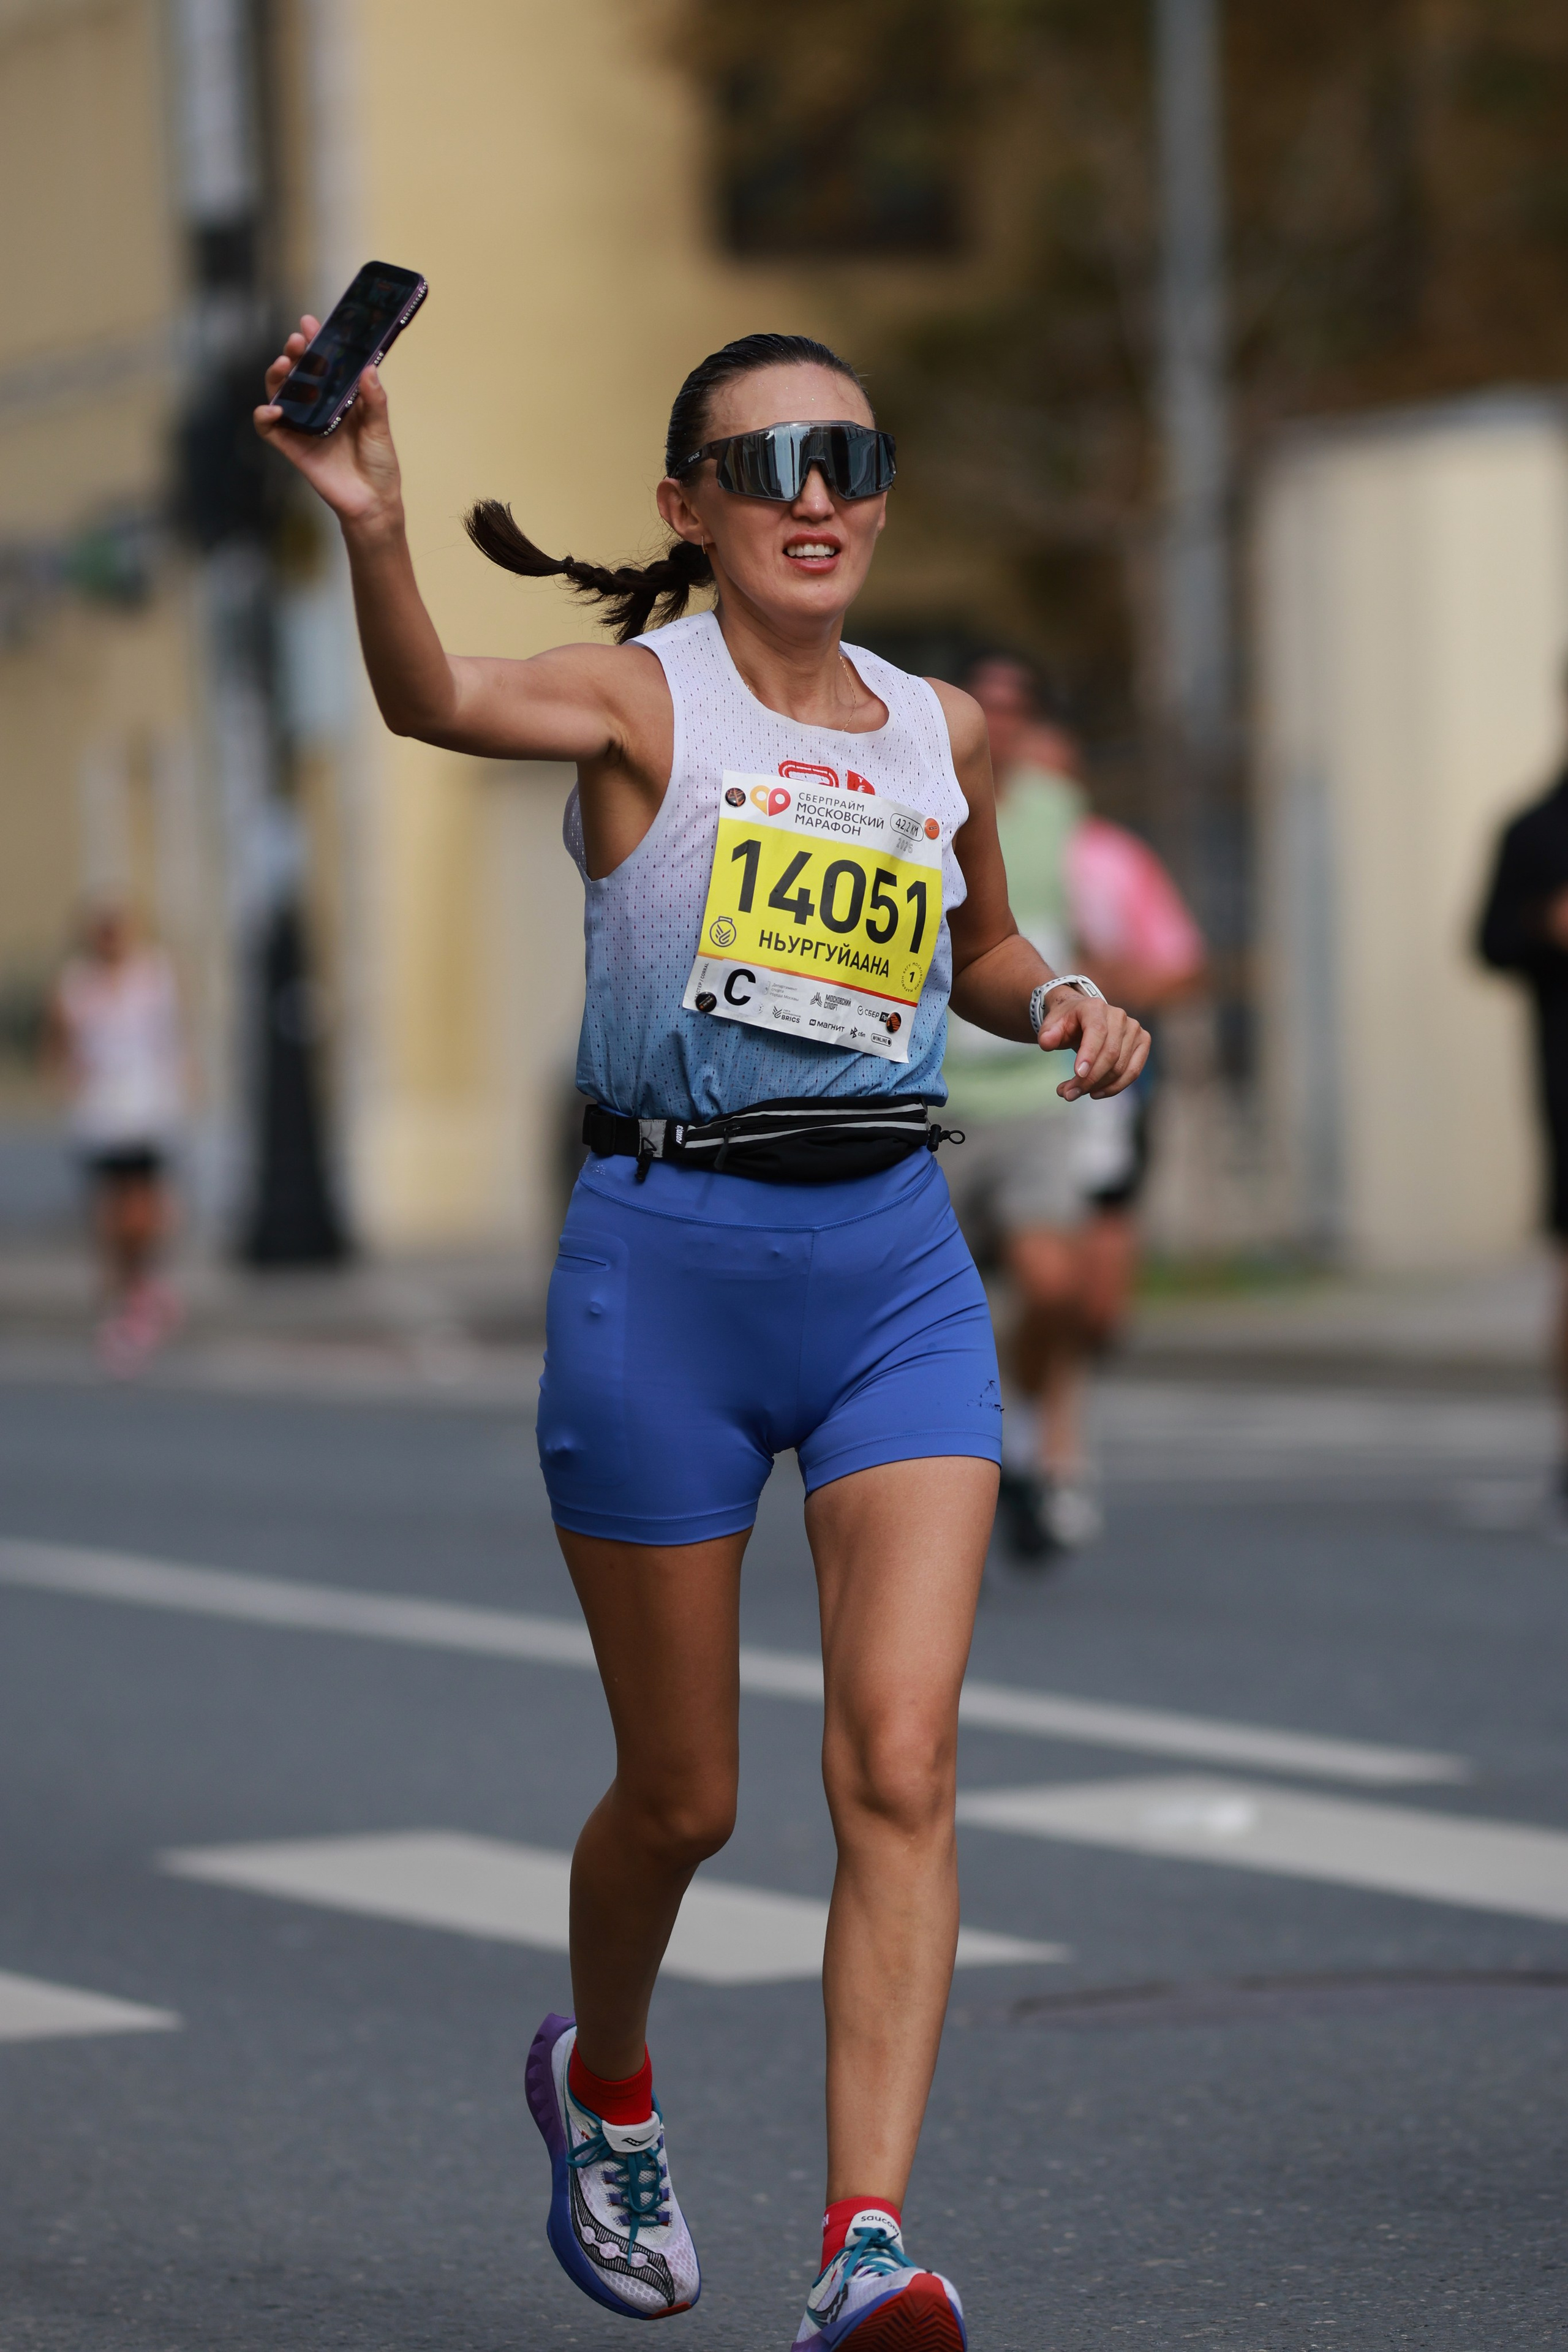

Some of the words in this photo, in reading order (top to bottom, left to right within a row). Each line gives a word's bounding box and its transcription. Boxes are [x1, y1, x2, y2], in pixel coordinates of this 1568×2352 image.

[798, 792, 865, 812] СБЕРПРАЙМ
[796, 802, 884, 829] МОСКОВСКИЙ
[794, 814, 861, 836] МАРАФОН
[895, 818, 911, 832] 42,2
[731, 839, 927, 954] 14051
[758, 929, 889, 978] НЬУРГУЙААНА
[700, 962, 709, 979] CORRAL
[909, 971, 915, 983] 1
[824, 1001, 838, 1011] СПОРТ
[825, 993, 851, 1008] МОСКОВСКИЙ
[781, 1014, 801, 1023] BRICS
[864, 1009, 880, 1018] СБЕР
[872, 1035, 888, 1044] WINLINE
